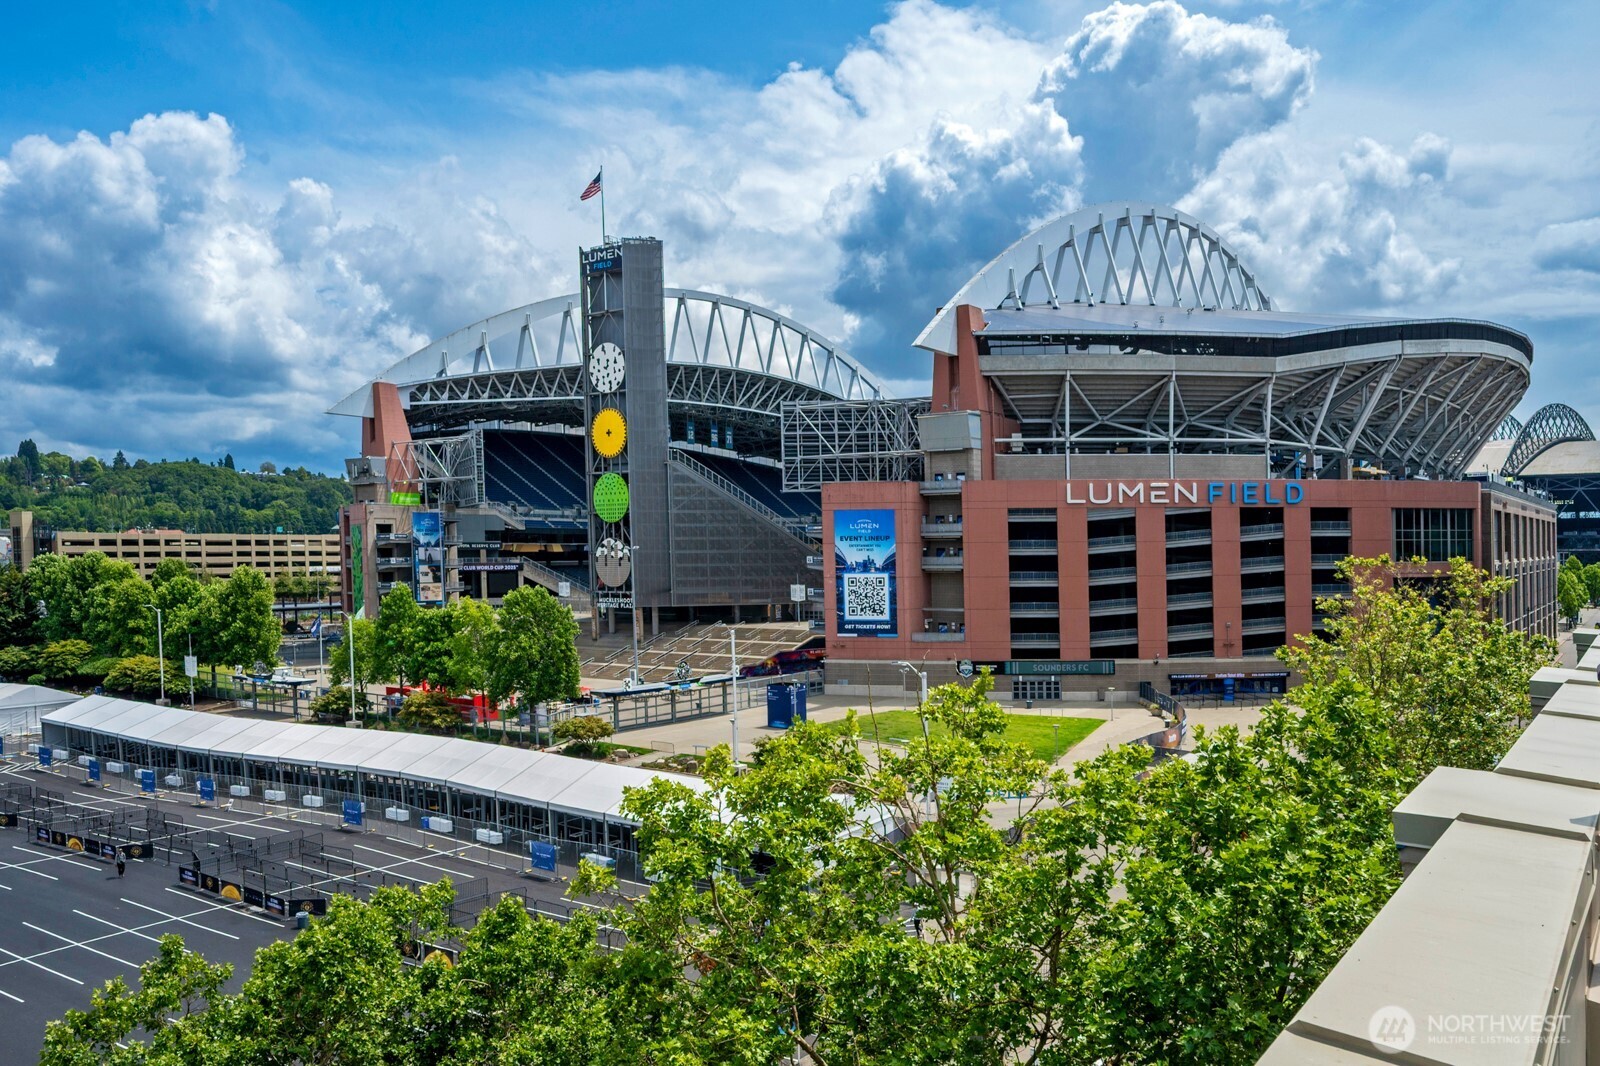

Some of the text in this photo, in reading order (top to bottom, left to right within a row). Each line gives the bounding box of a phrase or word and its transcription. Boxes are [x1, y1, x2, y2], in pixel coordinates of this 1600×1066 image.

[582, 247, 622, 263] LUMEN
[593, 260, 612, 270] FIELD
[1066, 482, 1304, 504] LUMEN FIELD
[1033, 663, 1089, 672] SOUNDERS FC
